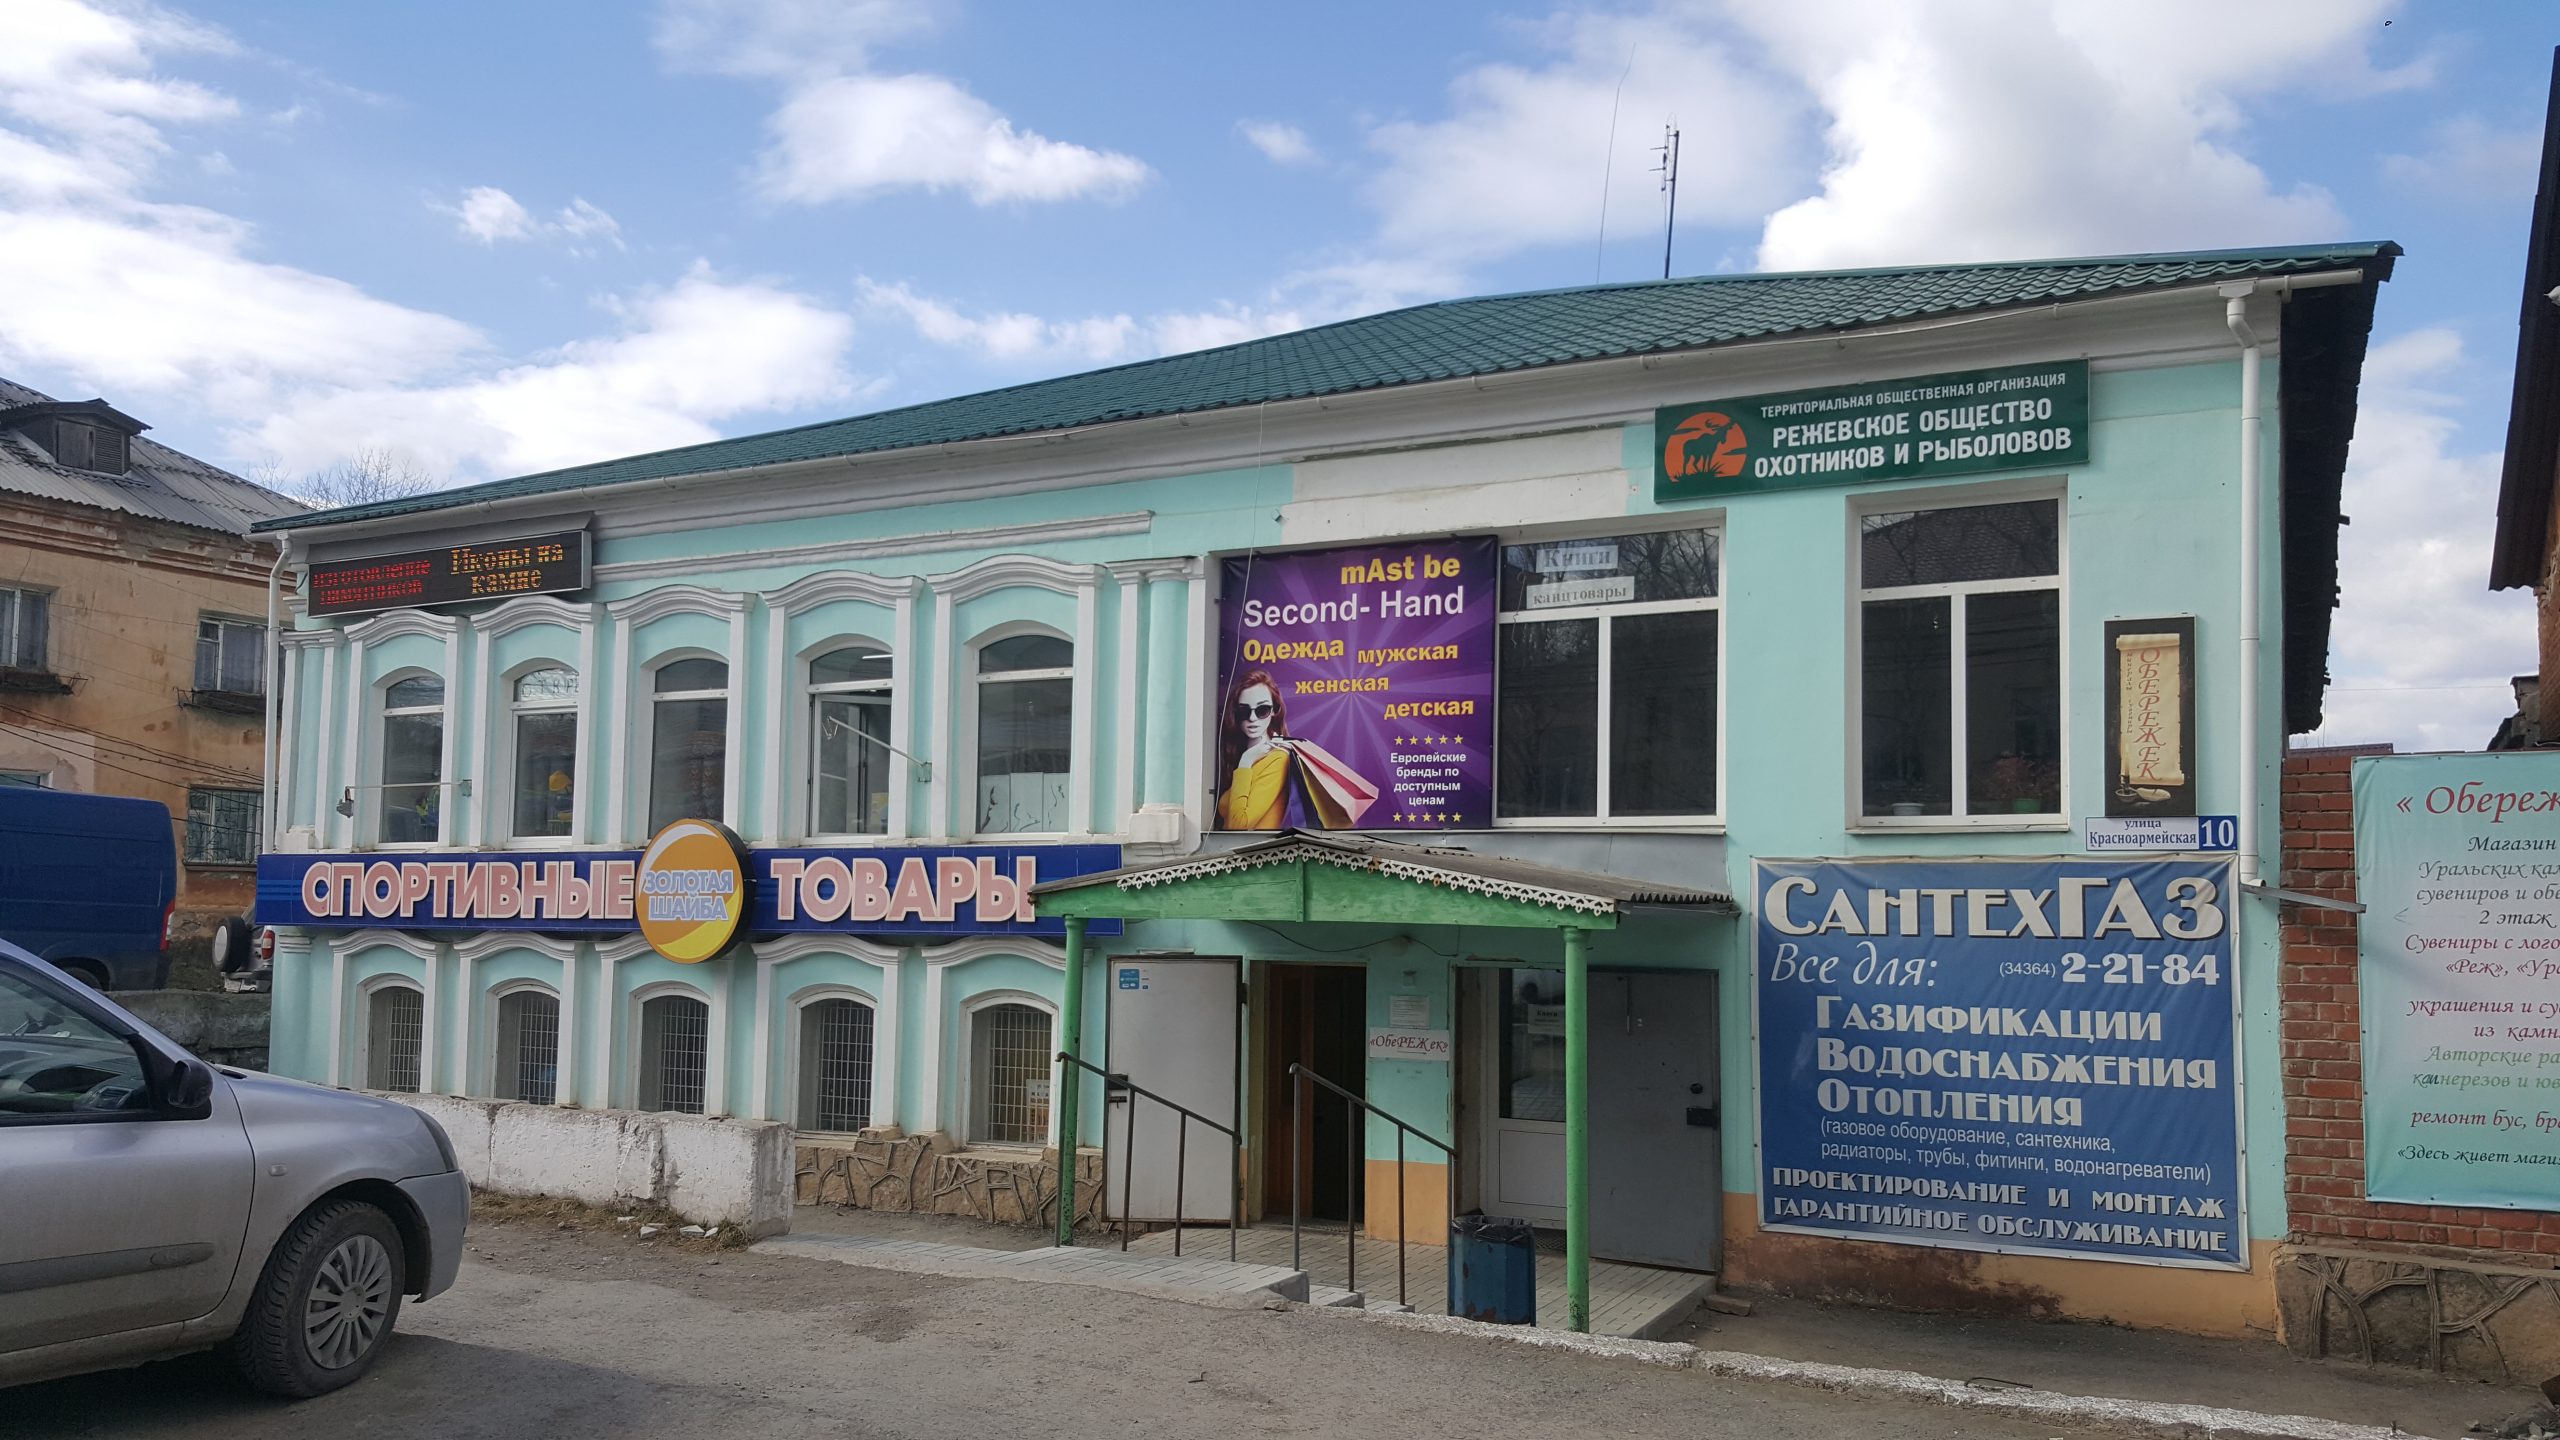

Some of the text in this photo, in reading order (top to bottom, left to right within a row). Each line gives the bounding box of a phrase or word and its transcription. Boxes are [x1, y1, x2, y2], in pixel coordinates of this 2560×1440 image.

[1761, 373, 2066, 418] ТЕРРИТОРИАЛЬНАЯ ОБЩЕСТВЕННАЯ ОРГАНИЗАЦИЯ
[1773, 398, 2052, 448] РЕЖЕВСКОЕ ОБЩЕСТВО
[1754, 427, 2072, 479] ОХОТНИКОВ И РЫБОЛОВОВ
[1545, 549, 1610, 567] Книги
[1340, 554, 1460, 584] mAst be
[1244, 585, 1463, 627] Second- Hand
[1533, 586, 1626, 605] канцтовары
[1243, 639, 1458, 667] Одежда мужская
[1295, 677, 1389, 694] женская
[1384, 700, 1474, 720] детская
[2133, 647, 2166, 781] ОБЕРЕЖЕК
[1390, 752, 1467, 765] Европейские
[1396, 766, 1459, 779] бренды по
[1393, 782, 1461, 793] доступным
[1408, 797, 1445, 807] ценам
[2089, 819, 2235, 848] Красноармейская 10
[2124, 819, 2161, 830] улица
[2468, 836, 2557, 851] Магазин
[2418, 860, 2528, 881] Уральских
[302, 856, 1036, 922] СПОРТИВНЫЕ ТОВАРЫ
[642, 869, 734, 894] ЗОЛОТАЯ
[648, 891, 729, 921] ШАЙБА
[2416, 889, 2509, 905] сувениров
[2516, 889, 2527, 900] и
[2479, 910, 2557, 928] 2 этаж
[2405, 934, 2497, 954] Сувениры
[2504, 938, 2514, 949] с
[1771, 940, 2220, 987] Все для: (34364) 2-21-84
[2446, 959, 2508, 977] «Реж»,
[2406, 1000, 2513, 1016] украшения
[2521, 1002, 2532, 1013] и
[2474, 1026, 2495, 1037] из
[2423, 1045, 2532, 1066] Авторские
[2517, 1077, 2528, 1088] и
[2410, 1111, 2486, 1128] ремонт
[2493, 1109, 2527, 1131] бус,
[1820, 1119, 2116, 1154] (газовое оборудование, сантехника,
[1821, 1142, 2210, 1183] радиаторы, трубы, фитинги, водонагреватели)
[2398, 1144, 2449, 1160] «Здесь
[2453, 1150, 2509, 1164] живет
[1772, 1167, 2226, 1219] ПРОЕКТИРОВАНИЕ И МОНТАЖ
[1774, 1197, 2228, 1252] ГАРАНТИЙНОЕ ОБСЛУЖИВАНИЕ
